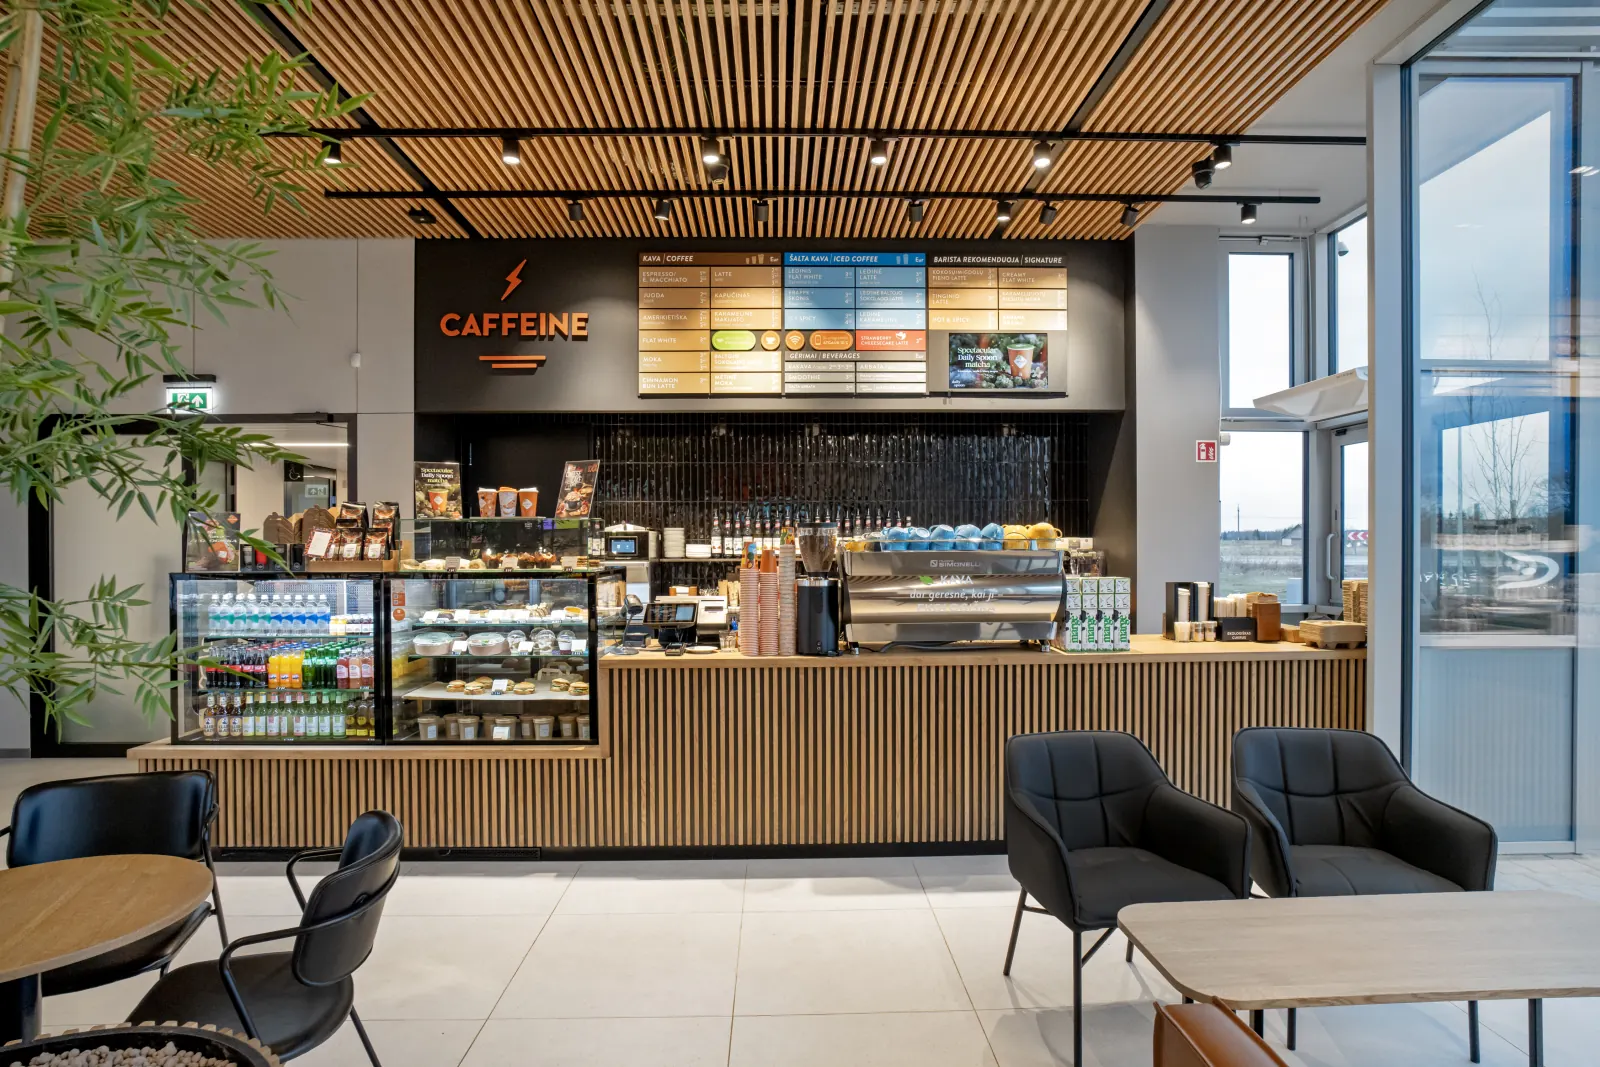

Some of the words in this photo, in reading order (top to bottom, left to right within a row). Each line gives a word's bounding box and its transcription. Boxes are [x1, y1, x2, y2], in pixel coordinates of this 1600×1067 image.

[440, 312, 588, 336] CAFFEINE
[940, 575, 974, 584] KAVA
[910, 589, 926, 598] dar
[928, 589, 968, 601] geresnė,
[971, 588, 985, 598] kai
